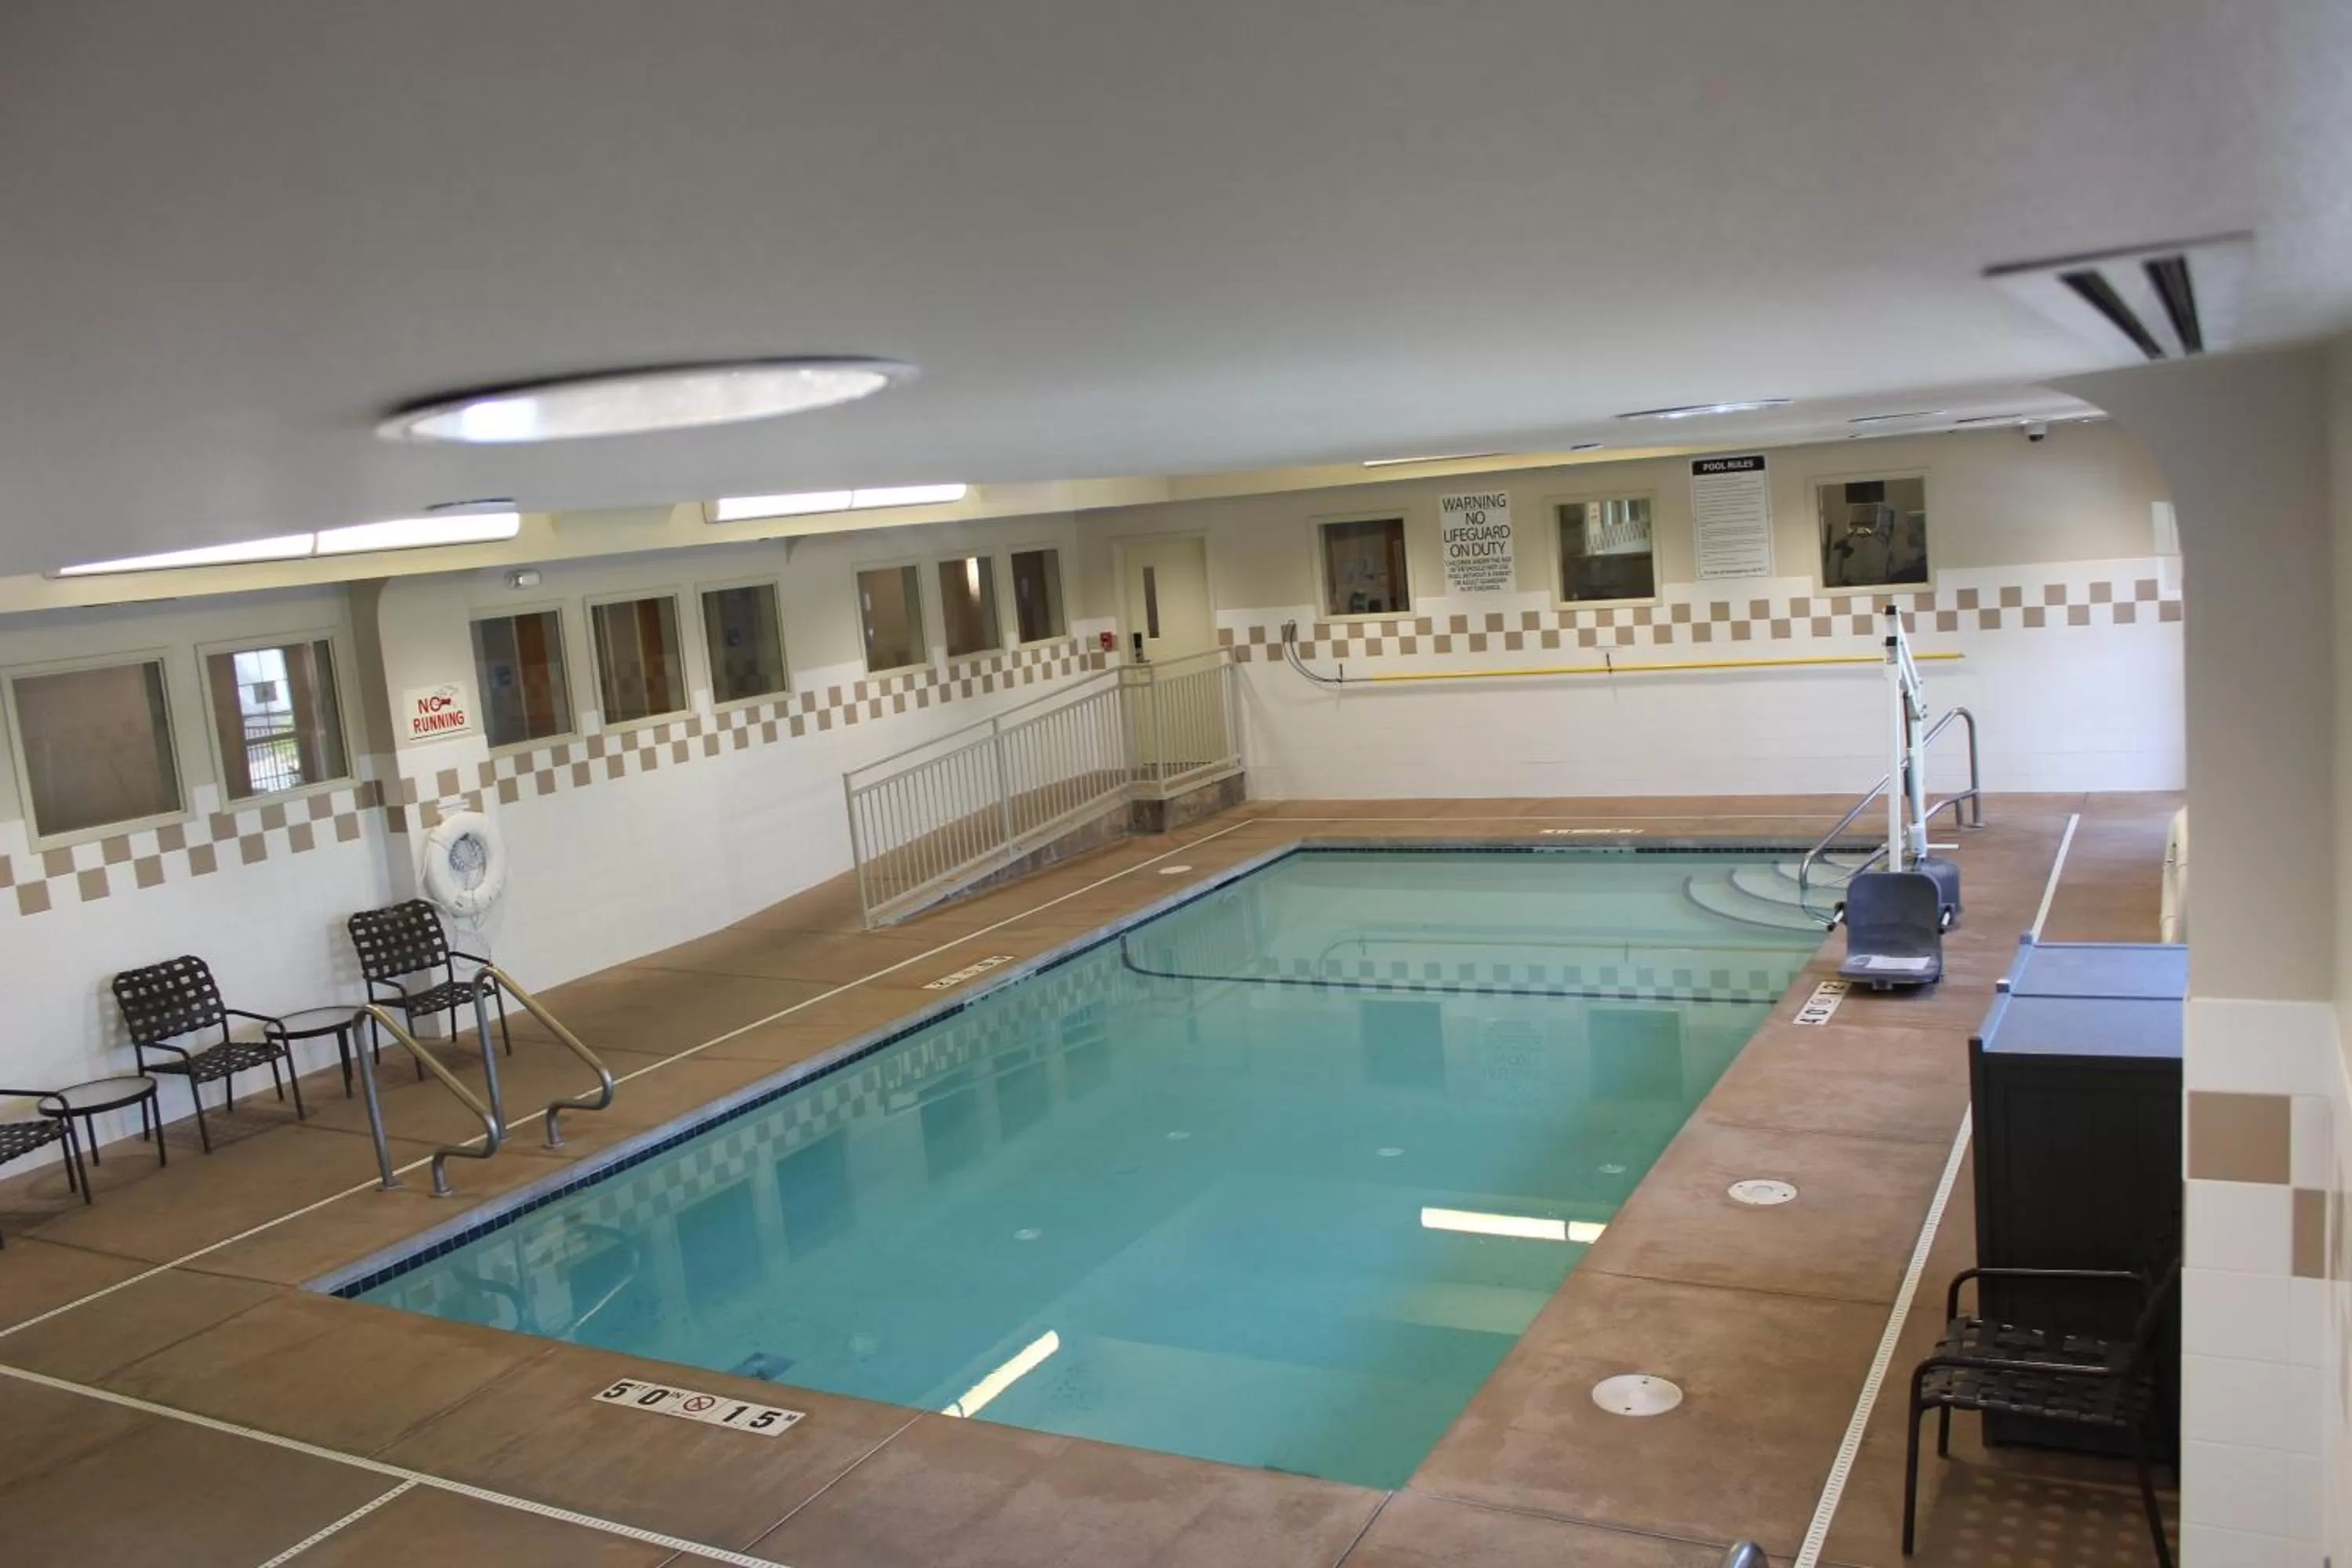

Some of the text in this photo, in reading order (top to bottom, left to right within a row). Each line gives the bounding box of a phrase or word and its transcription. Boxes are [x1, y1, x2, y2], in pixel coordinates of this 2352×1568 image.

[1702, 462, 1726, 471] POOL
[1442, 493, 1506, 512] WARNING
[1465, 510, 1486, 525] NO
[1443, 524, 1511, 543] LIFEGUARD
[1450, 541, 1505, 557] ON DUTY
[413, 710, 465, 734] RUNNING
